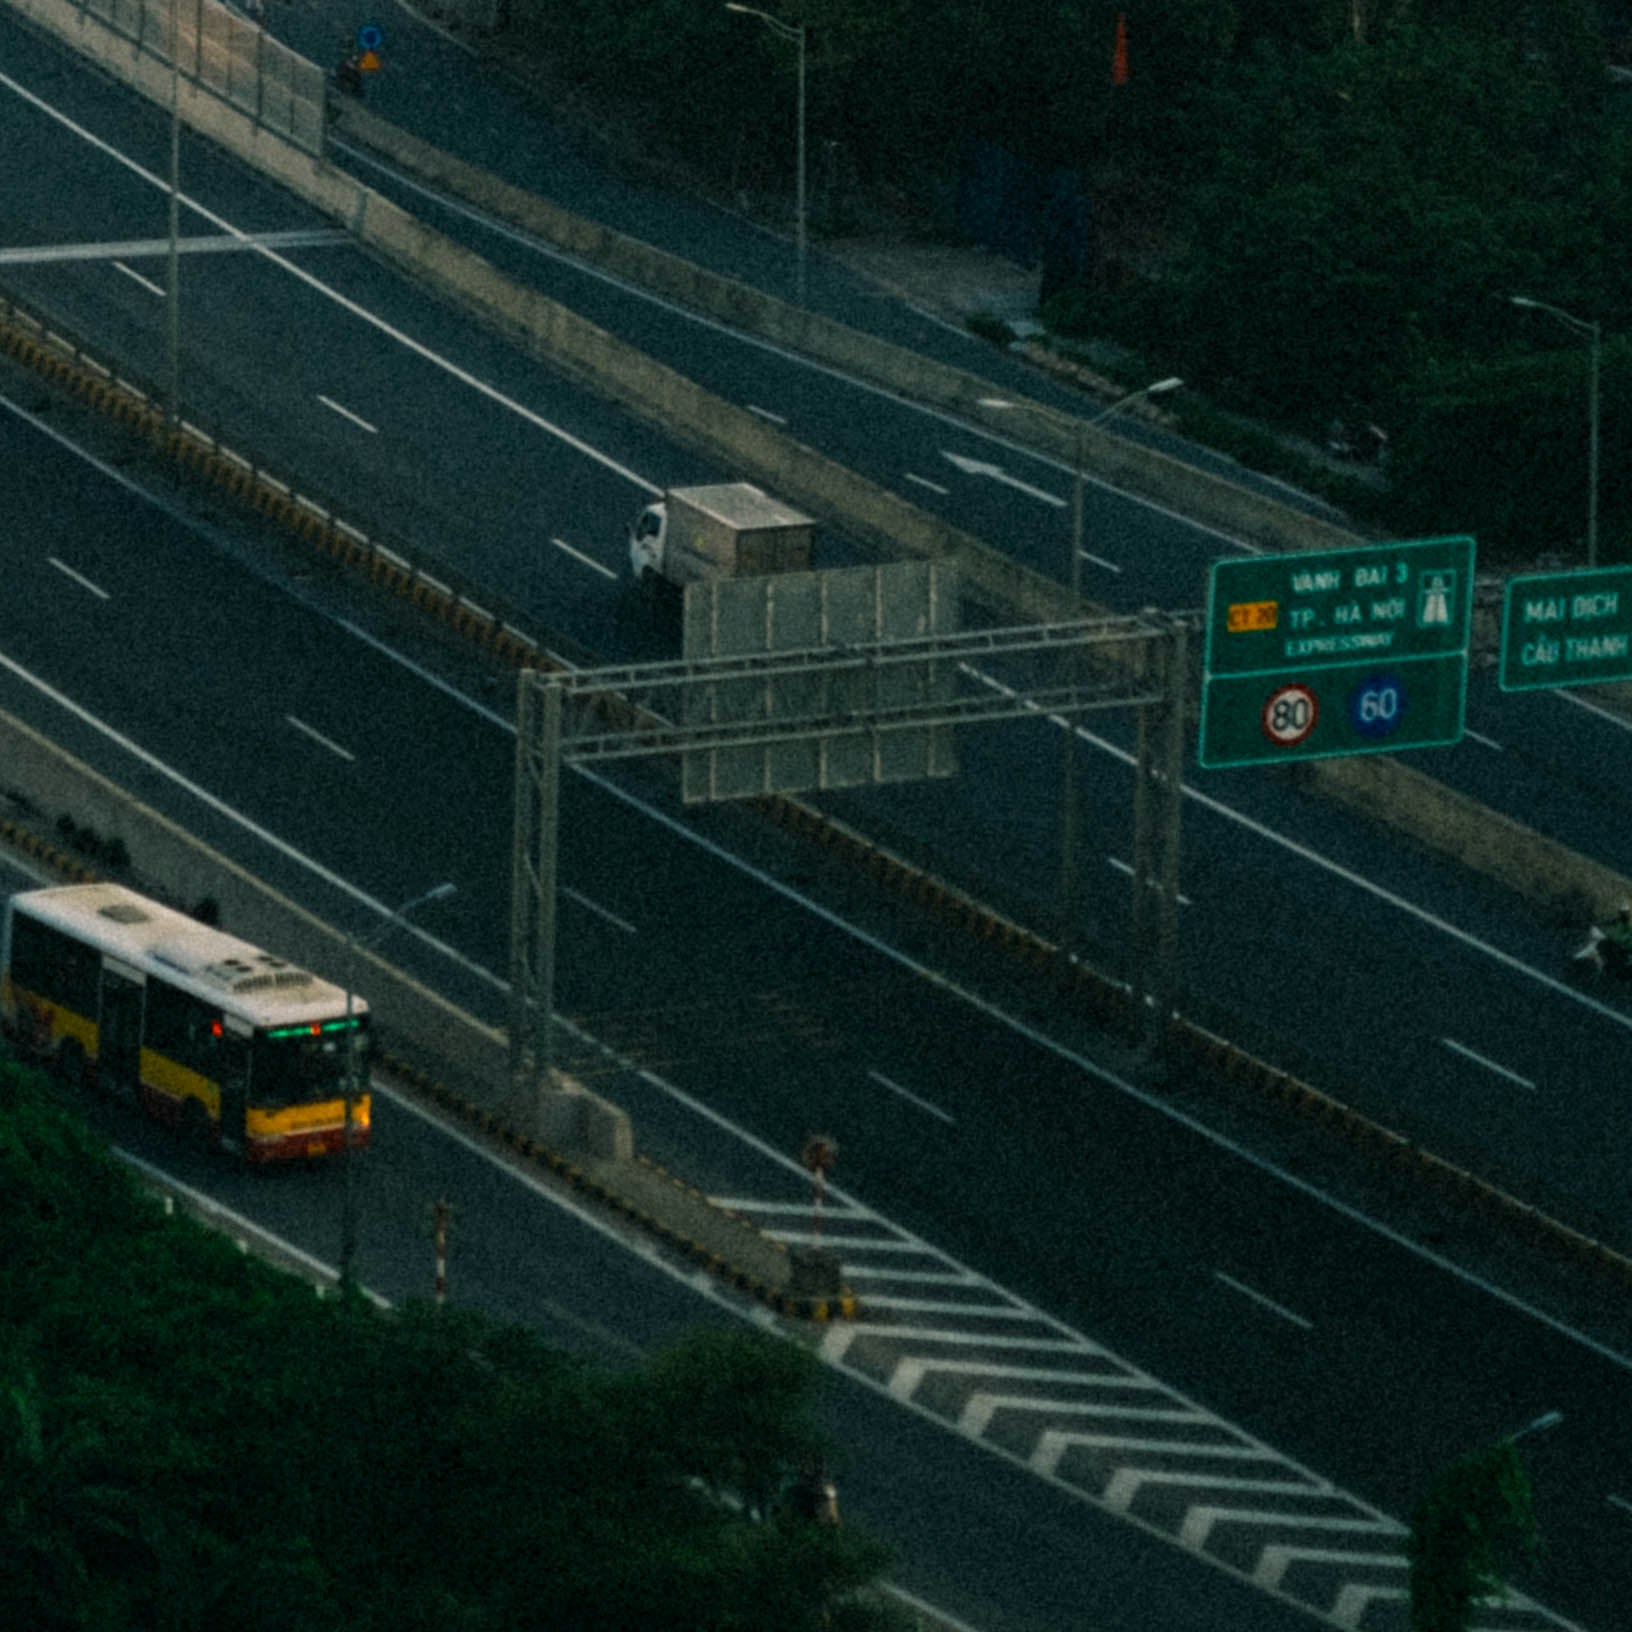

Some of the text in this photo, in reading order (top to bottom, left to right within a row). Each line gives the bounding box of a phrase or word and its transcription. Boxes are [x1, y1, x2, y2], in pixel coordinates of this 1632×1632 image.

[1395, 562, 1408, 584] 3
[1289, 607, 1326, 630] TP.
[1333, 599, 1363, 625] HÀ
[1523, 591, 1619, 624] MAI DỊCH
[1285, 630, 1395, 657] EXPRESSWAY
[1565, 634, 1629, 663] THANH
[1272, 697, 1311, 732] 80
[1360, 688, 1398, 723] 60
